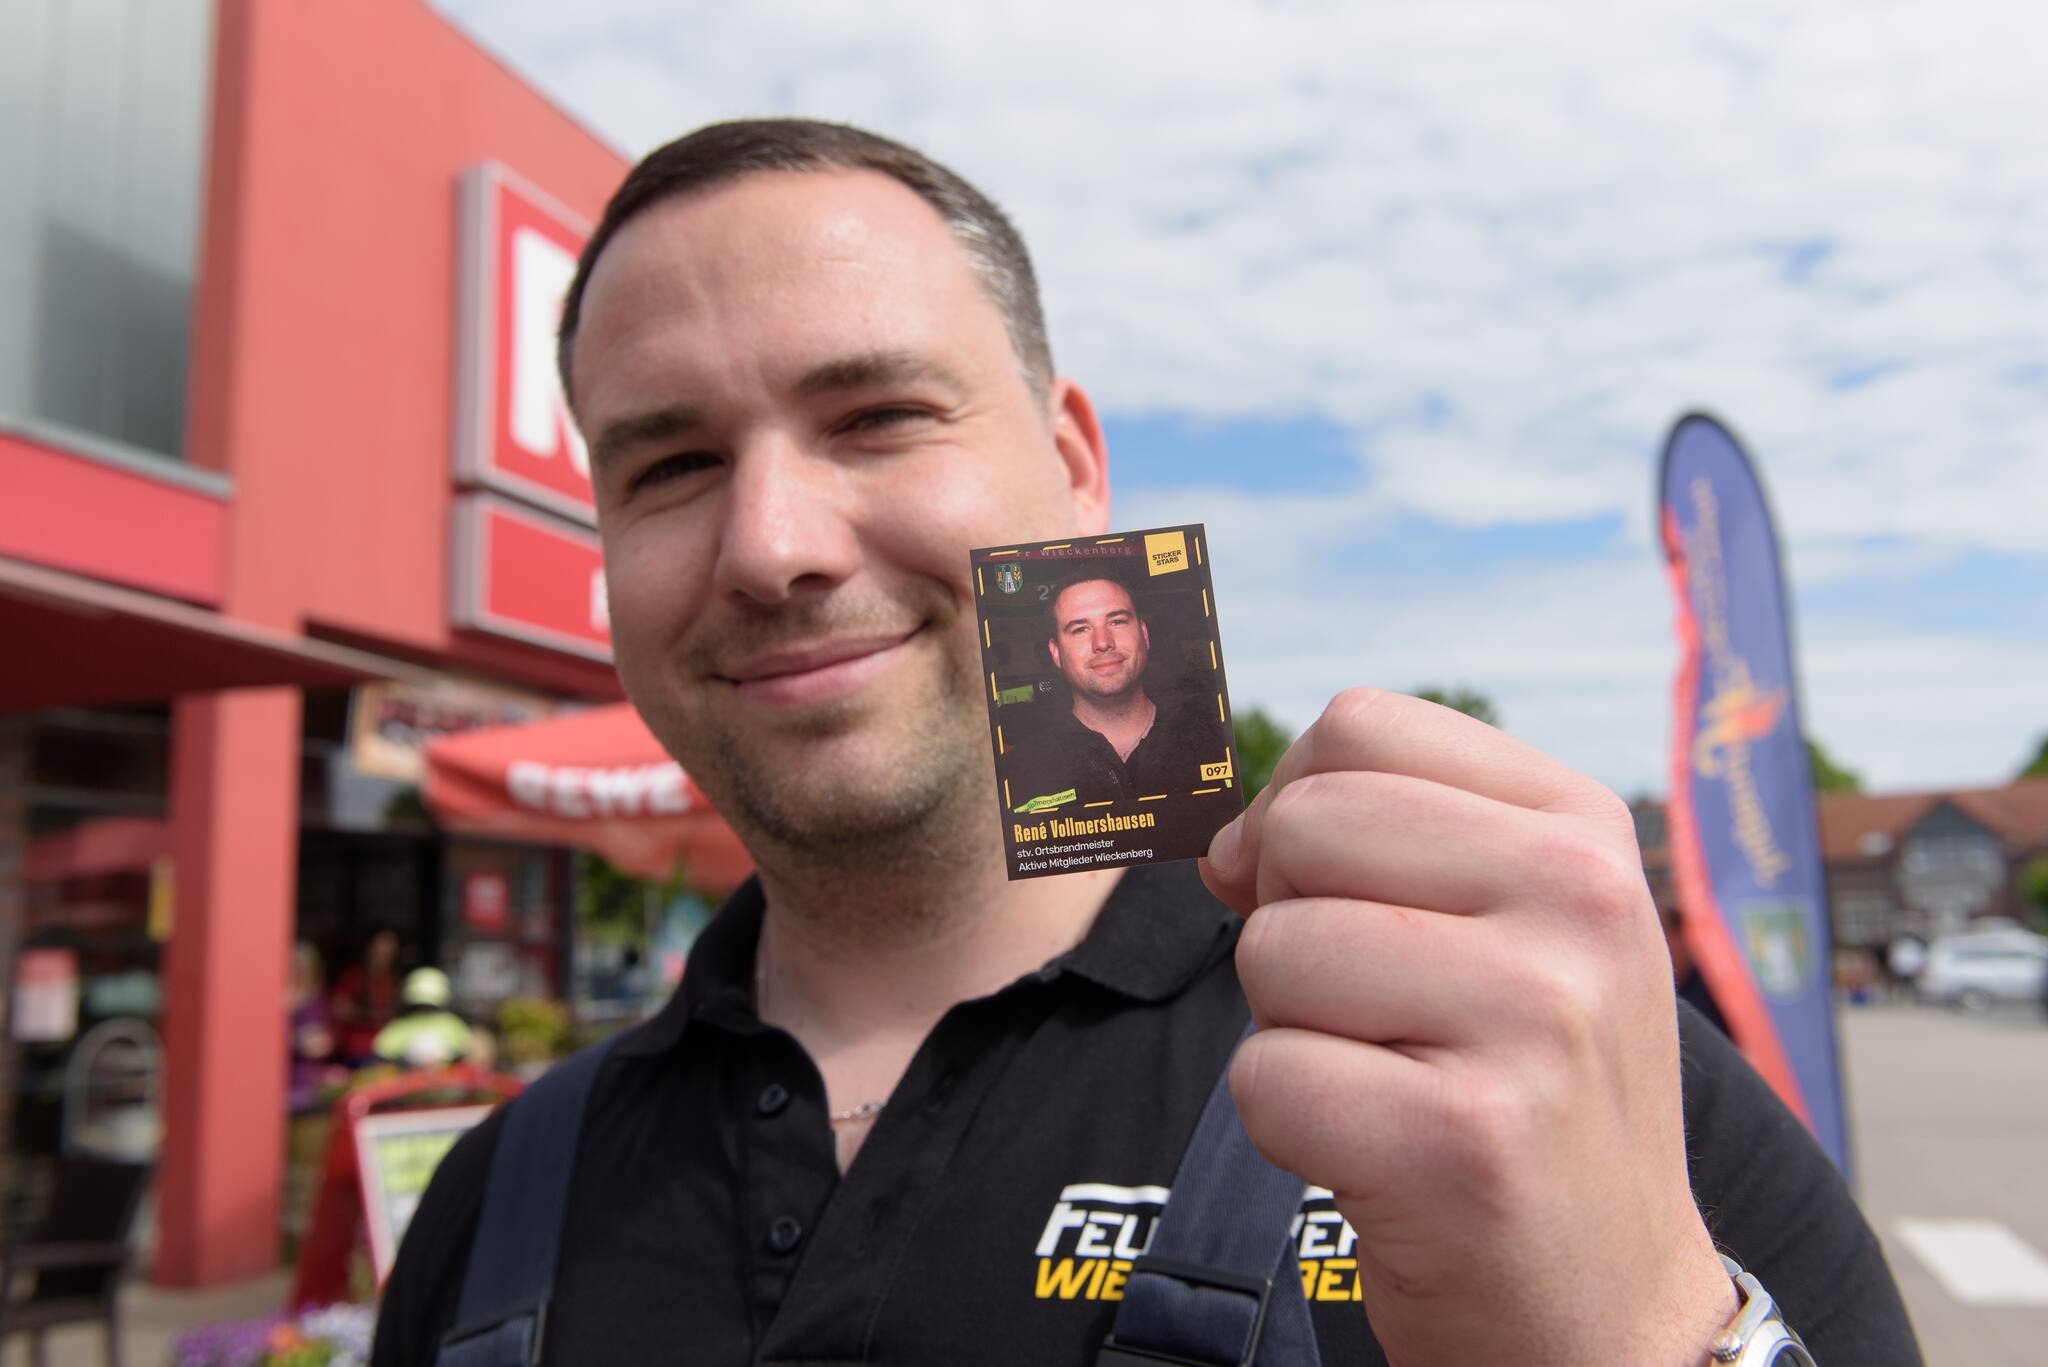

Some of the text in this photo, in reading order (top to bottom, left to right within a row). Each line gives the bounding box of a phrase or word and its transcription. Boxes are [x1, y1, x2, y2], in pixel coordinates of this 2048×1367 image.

[1152, 550, 1182, 561] STICKER
[1156, 556, 1180, 566] STARS
[1206, 765, 1229, 777] 097
[507, 760, 692, 818] REWE
[1013, 813, 1155, 843] René Vollmershausen
[1017, 838, 1116, 858] stv. Ortsbrandmeister
[1018, 847, 1154, 872] Aktive Mitglieder Wieckenberg
